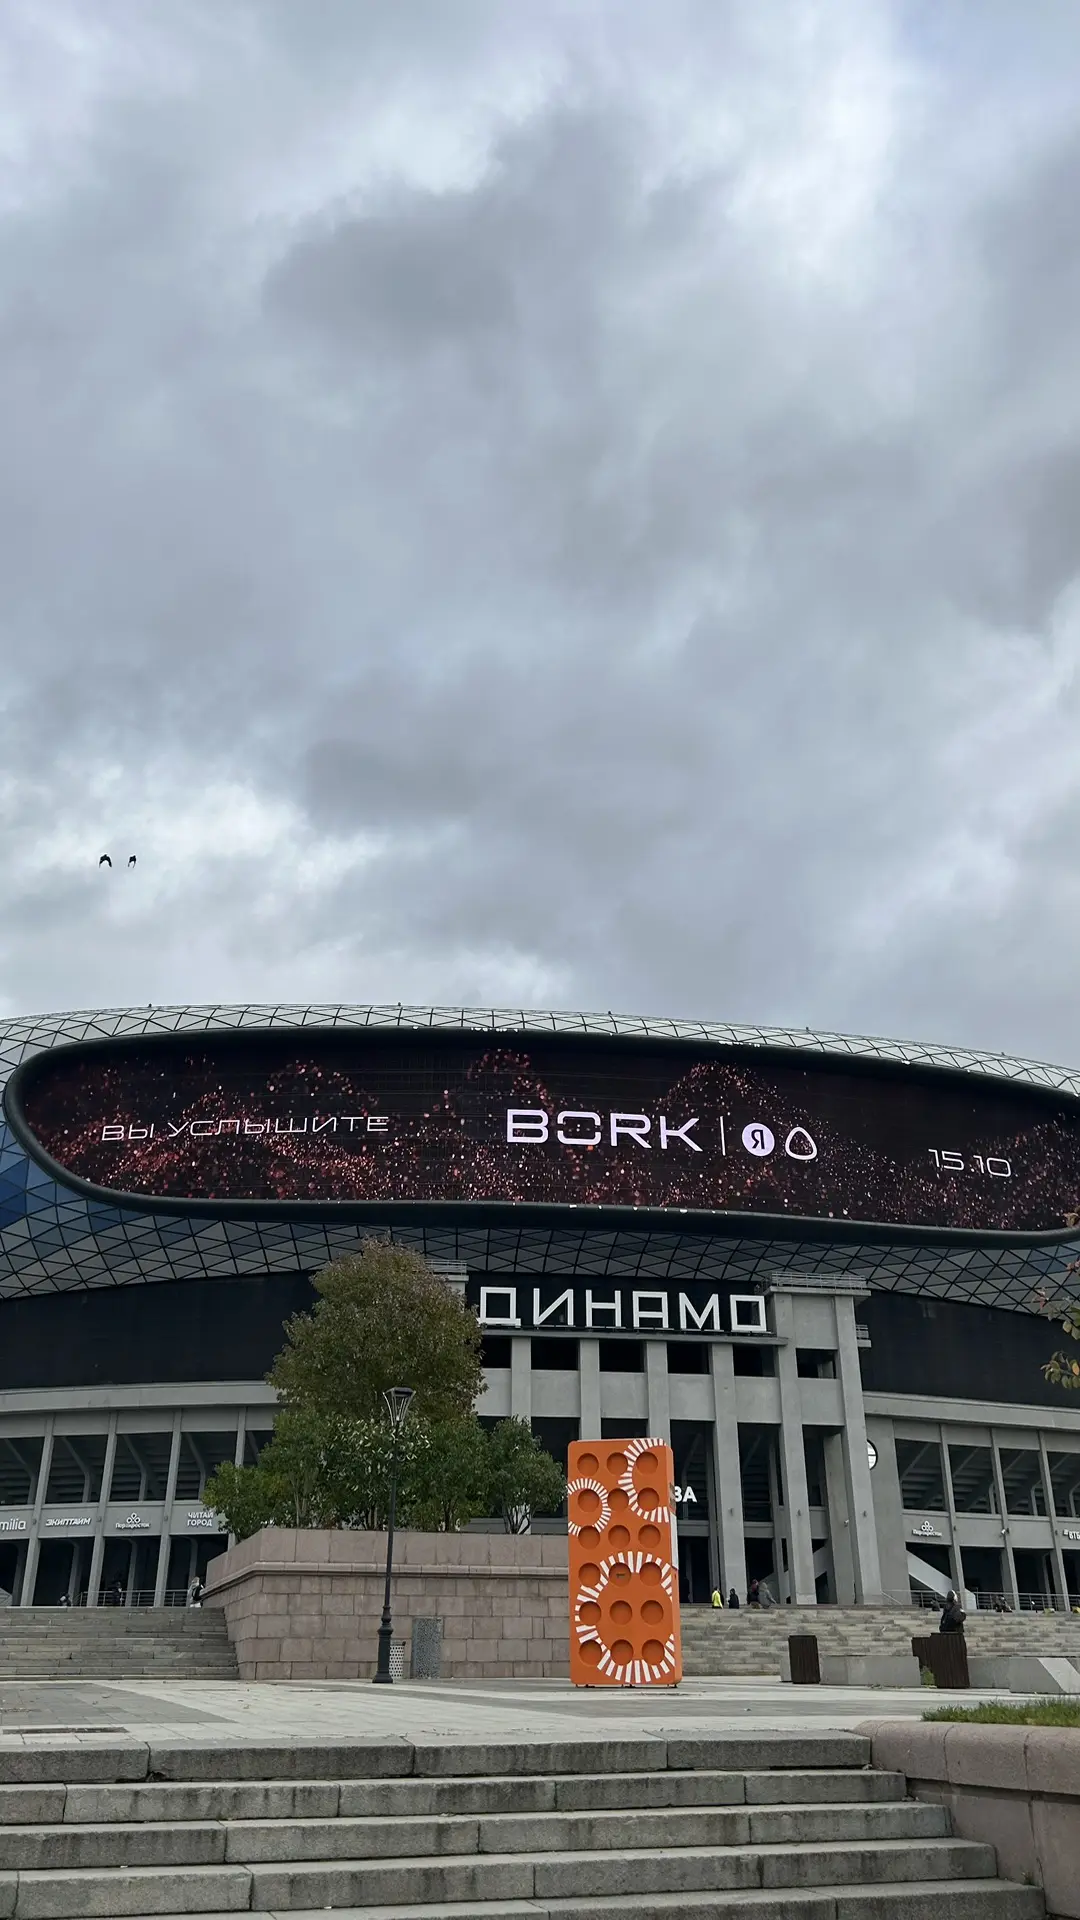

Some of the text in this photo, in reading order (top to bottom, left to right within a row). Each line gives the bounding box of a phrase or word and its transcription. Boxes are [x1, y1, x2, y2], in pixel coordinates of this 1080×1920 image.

[101, 1116, 389, 1141] ВЫ УСЛЫШИТЕ
[506, 1108, 703, 1152] BORK
[928, 1148, 1011, 1177] 15.10
[477, 1286, 768, 1333] ДИНАМО
[187, 1511, 214, 1519] ЧИТАЙ
[187, 1519, 213, 1527] ГОРОД
